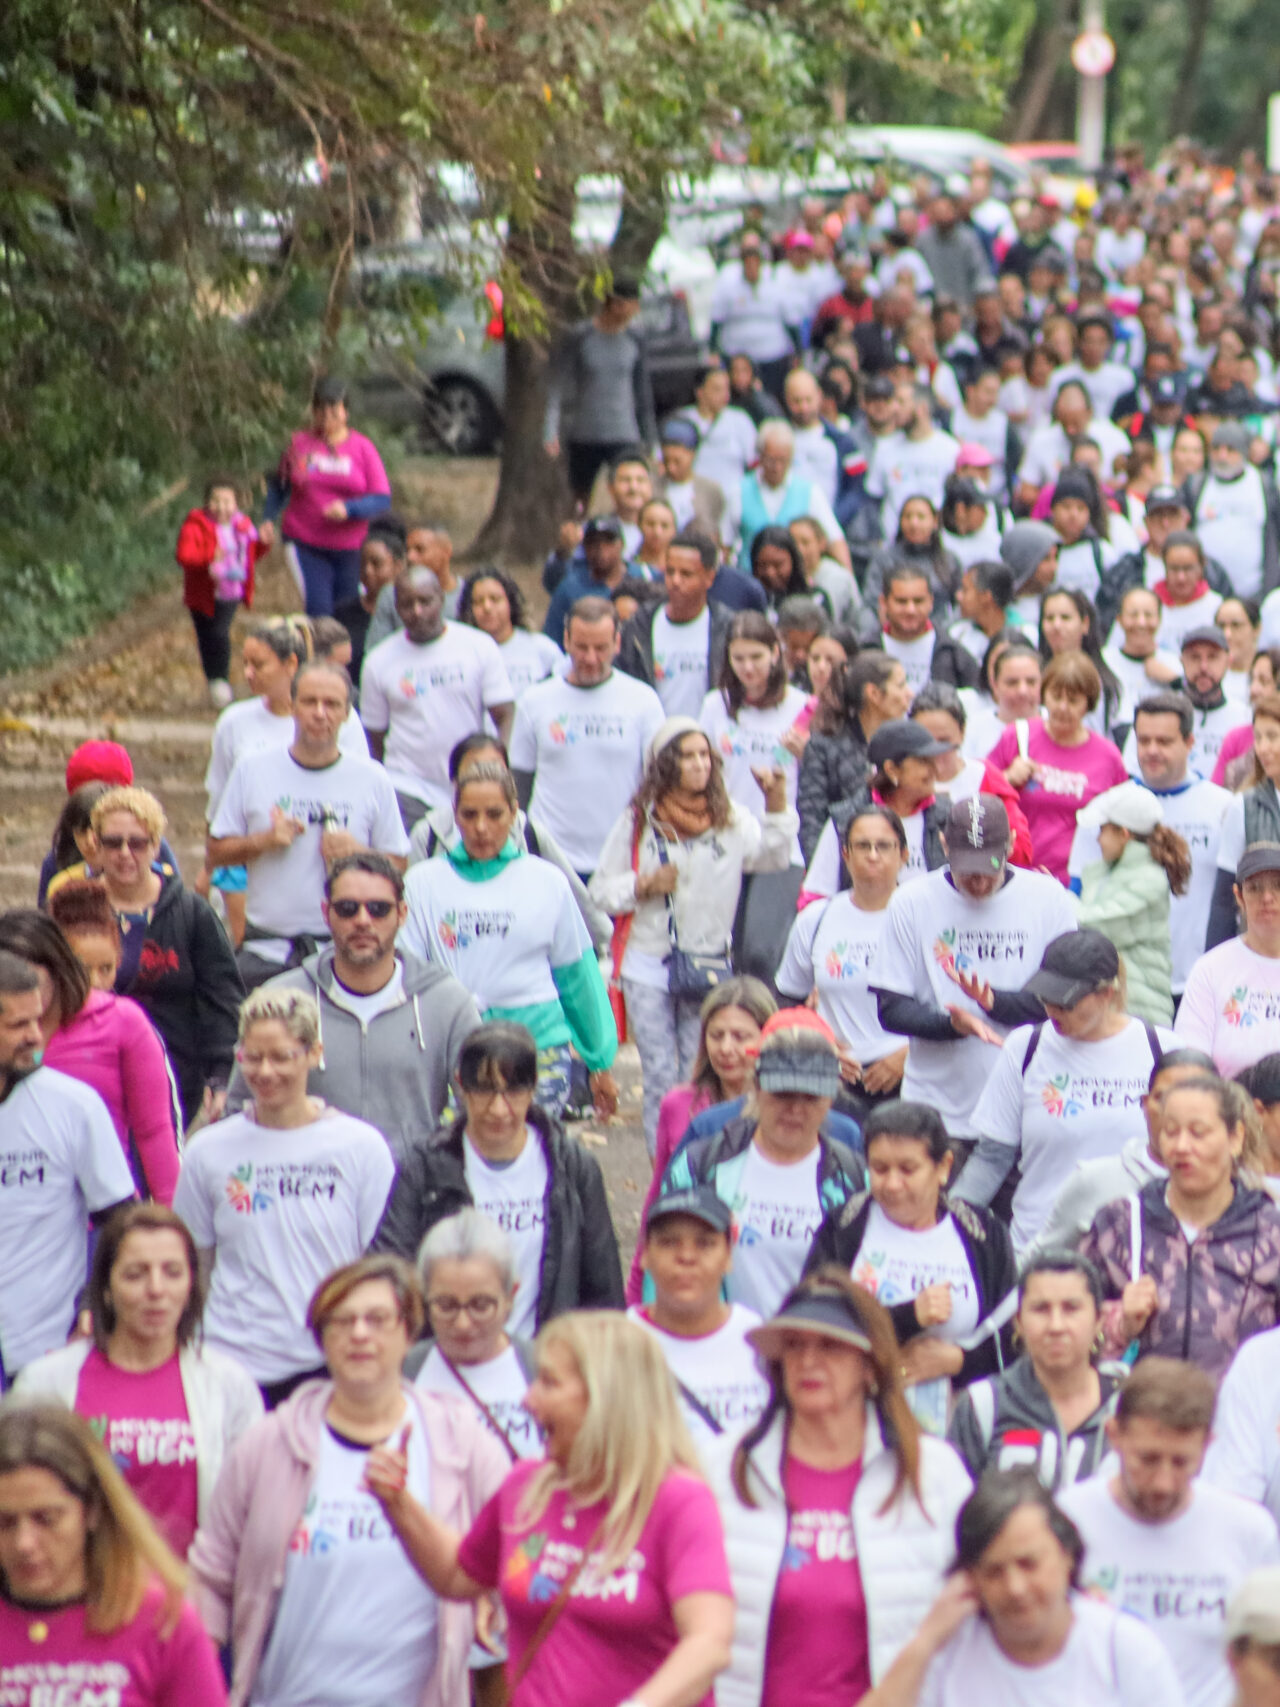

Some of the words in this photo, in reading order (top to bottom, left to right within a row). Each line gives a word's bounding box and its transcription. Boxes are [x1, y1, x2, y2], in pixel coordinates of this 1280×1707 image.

[958, 929, 1029, 944] MOVIMENTO
[977, 944, 1024, 961] BEM
[1092, 1090, 1143, 1108] BEM
[1, 1167, 44, 1187] EM
[256, 1165, 342, 1179] MOVIMENTO
[278, 1177, 336, 1200] BEM
[1153, 1591, 1226, 1622] BEM
